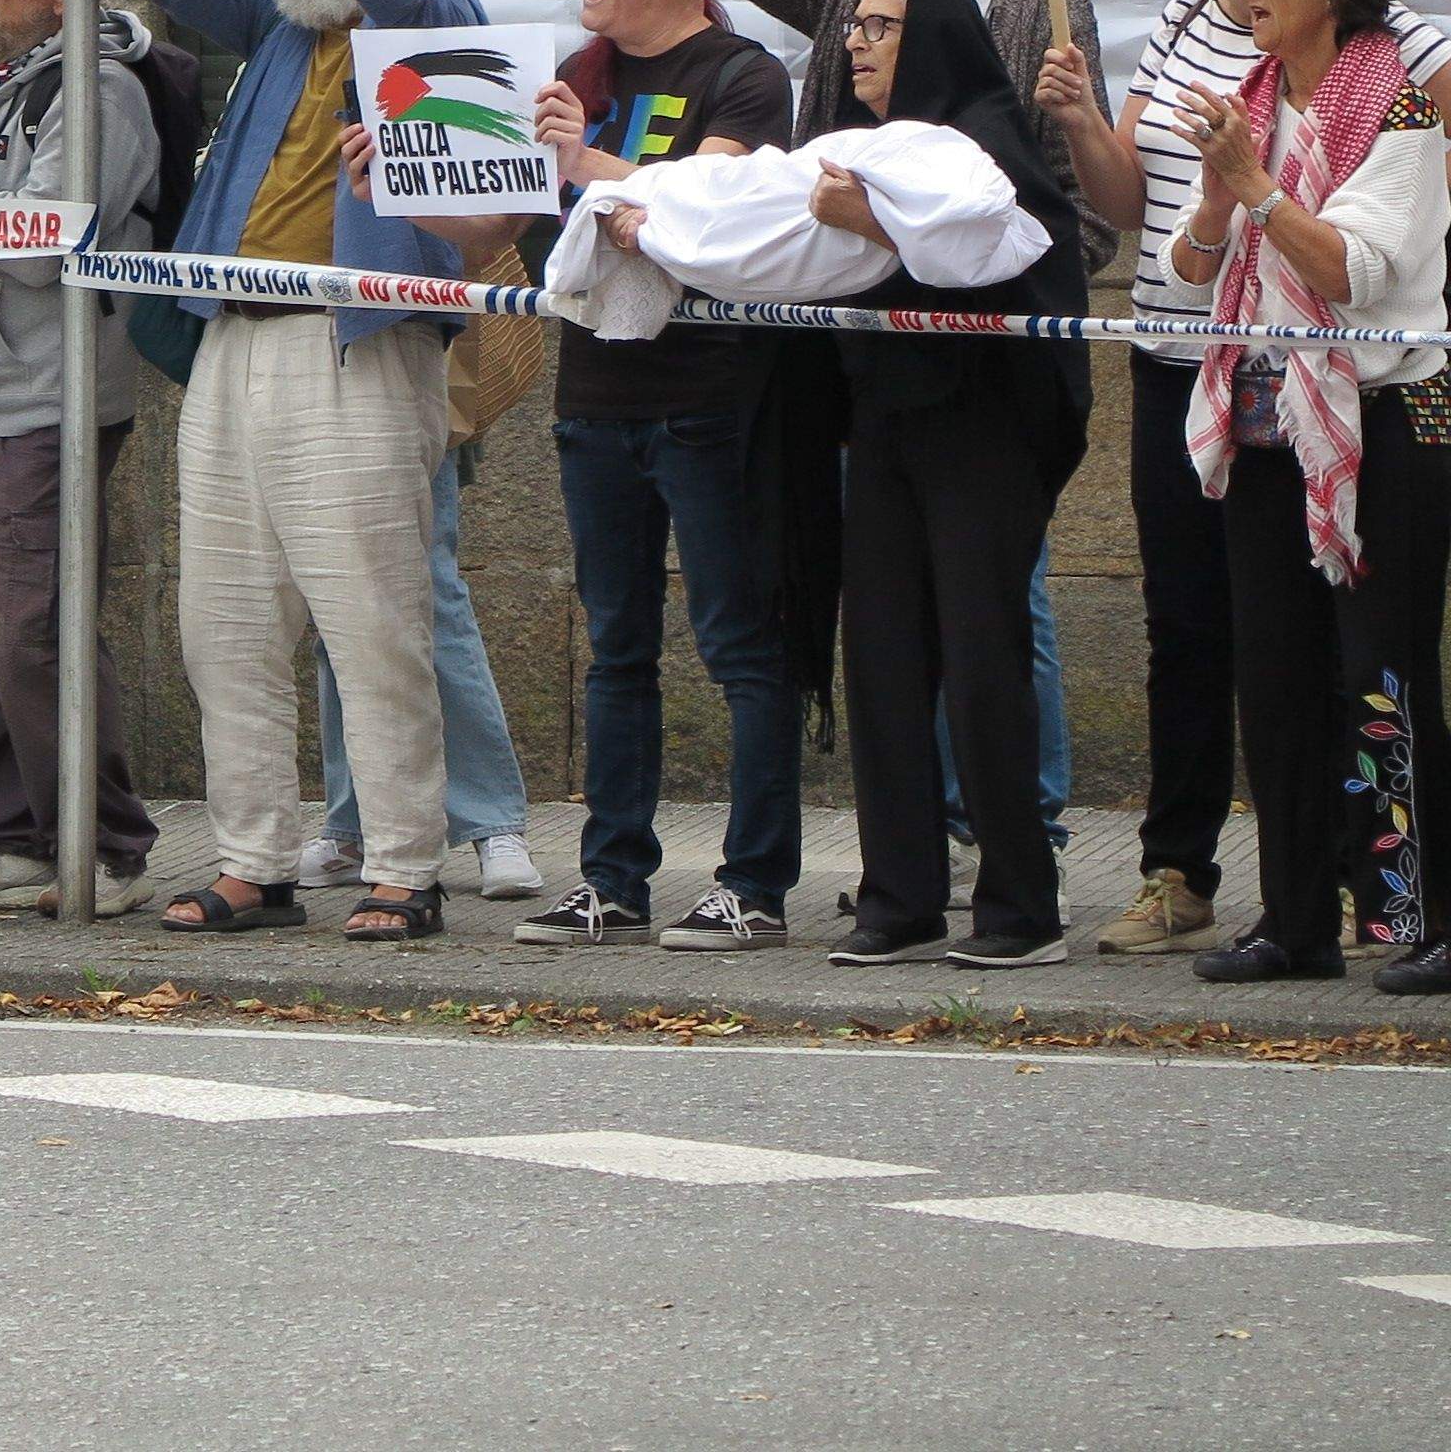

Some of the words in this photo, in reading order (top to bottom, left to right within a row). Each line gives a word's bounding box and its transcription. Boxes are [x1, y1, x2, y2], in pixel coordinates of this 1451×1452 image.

[378, 122, 452, 158] GALIZA
[384, 160, 429, 197] CON
[435, 157, 549, 196] PALESTINA
